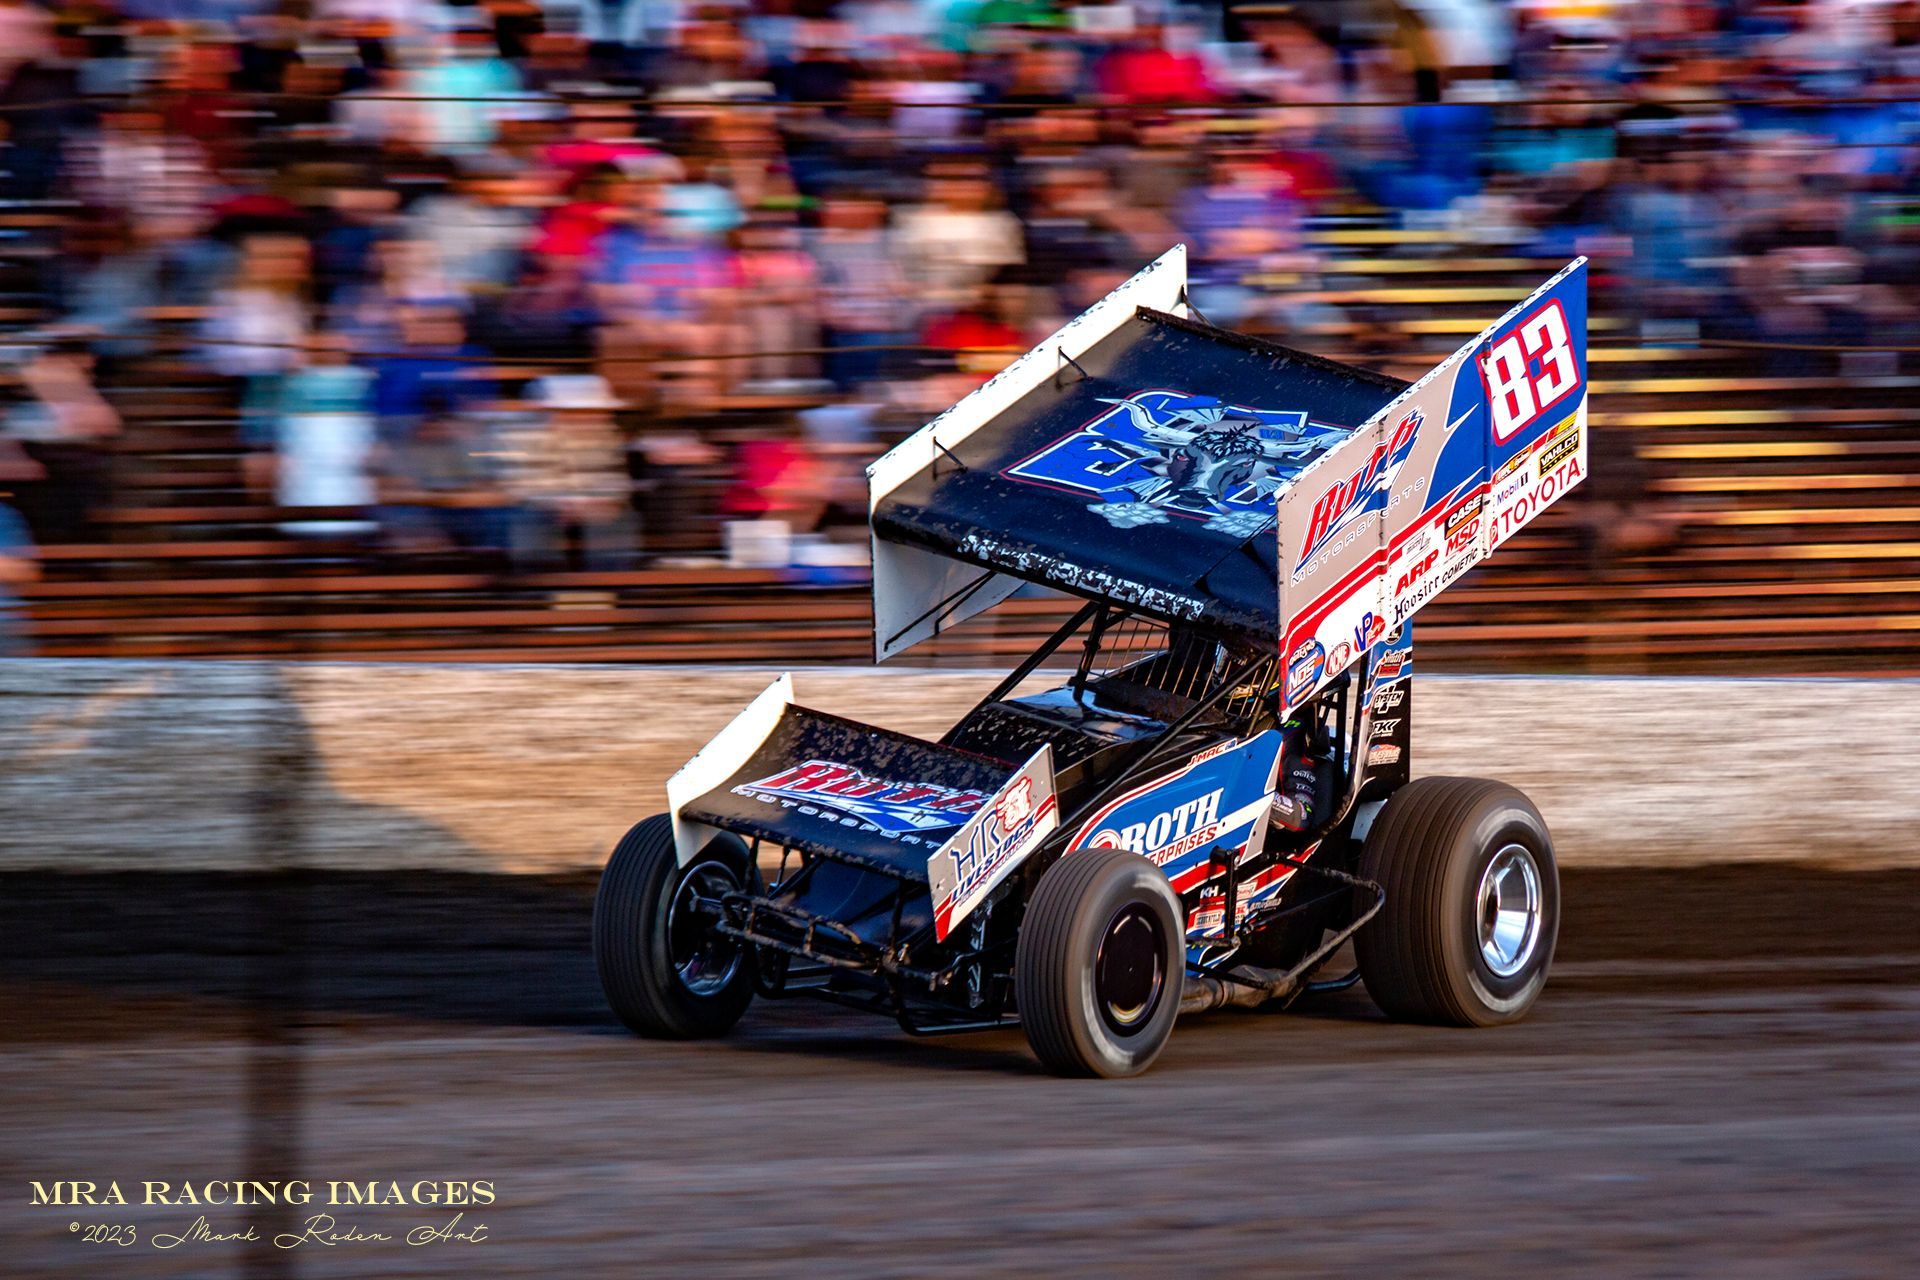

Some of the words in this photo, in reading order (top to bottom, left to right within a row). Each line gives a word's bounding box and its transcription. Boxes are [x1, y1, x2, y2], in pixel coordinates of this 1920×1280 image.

[1481, 302, 1579, 442] 83
[1540, 432, 1578, 467] VAHLCO
[1447, 493, 1482, 528] CASE
[1497, 478, 1520, 503] Mobil
[1501, 457, 1581, 534] TOYOTA
[1445, 519, 1479, 557] MSD
[1394, 549, 1440, 598] ARP
[1441, 547, 1479, 584] COMETIC
[1354, 611, 1373, 652] VP
[1288, 651, 1319, 692] NOS
[730, 784, 942, 849] MOTORSPORT
[1120, 787, 1225, 856] ROTH
[951, 814, 1036, 902] LIVESTOCK
